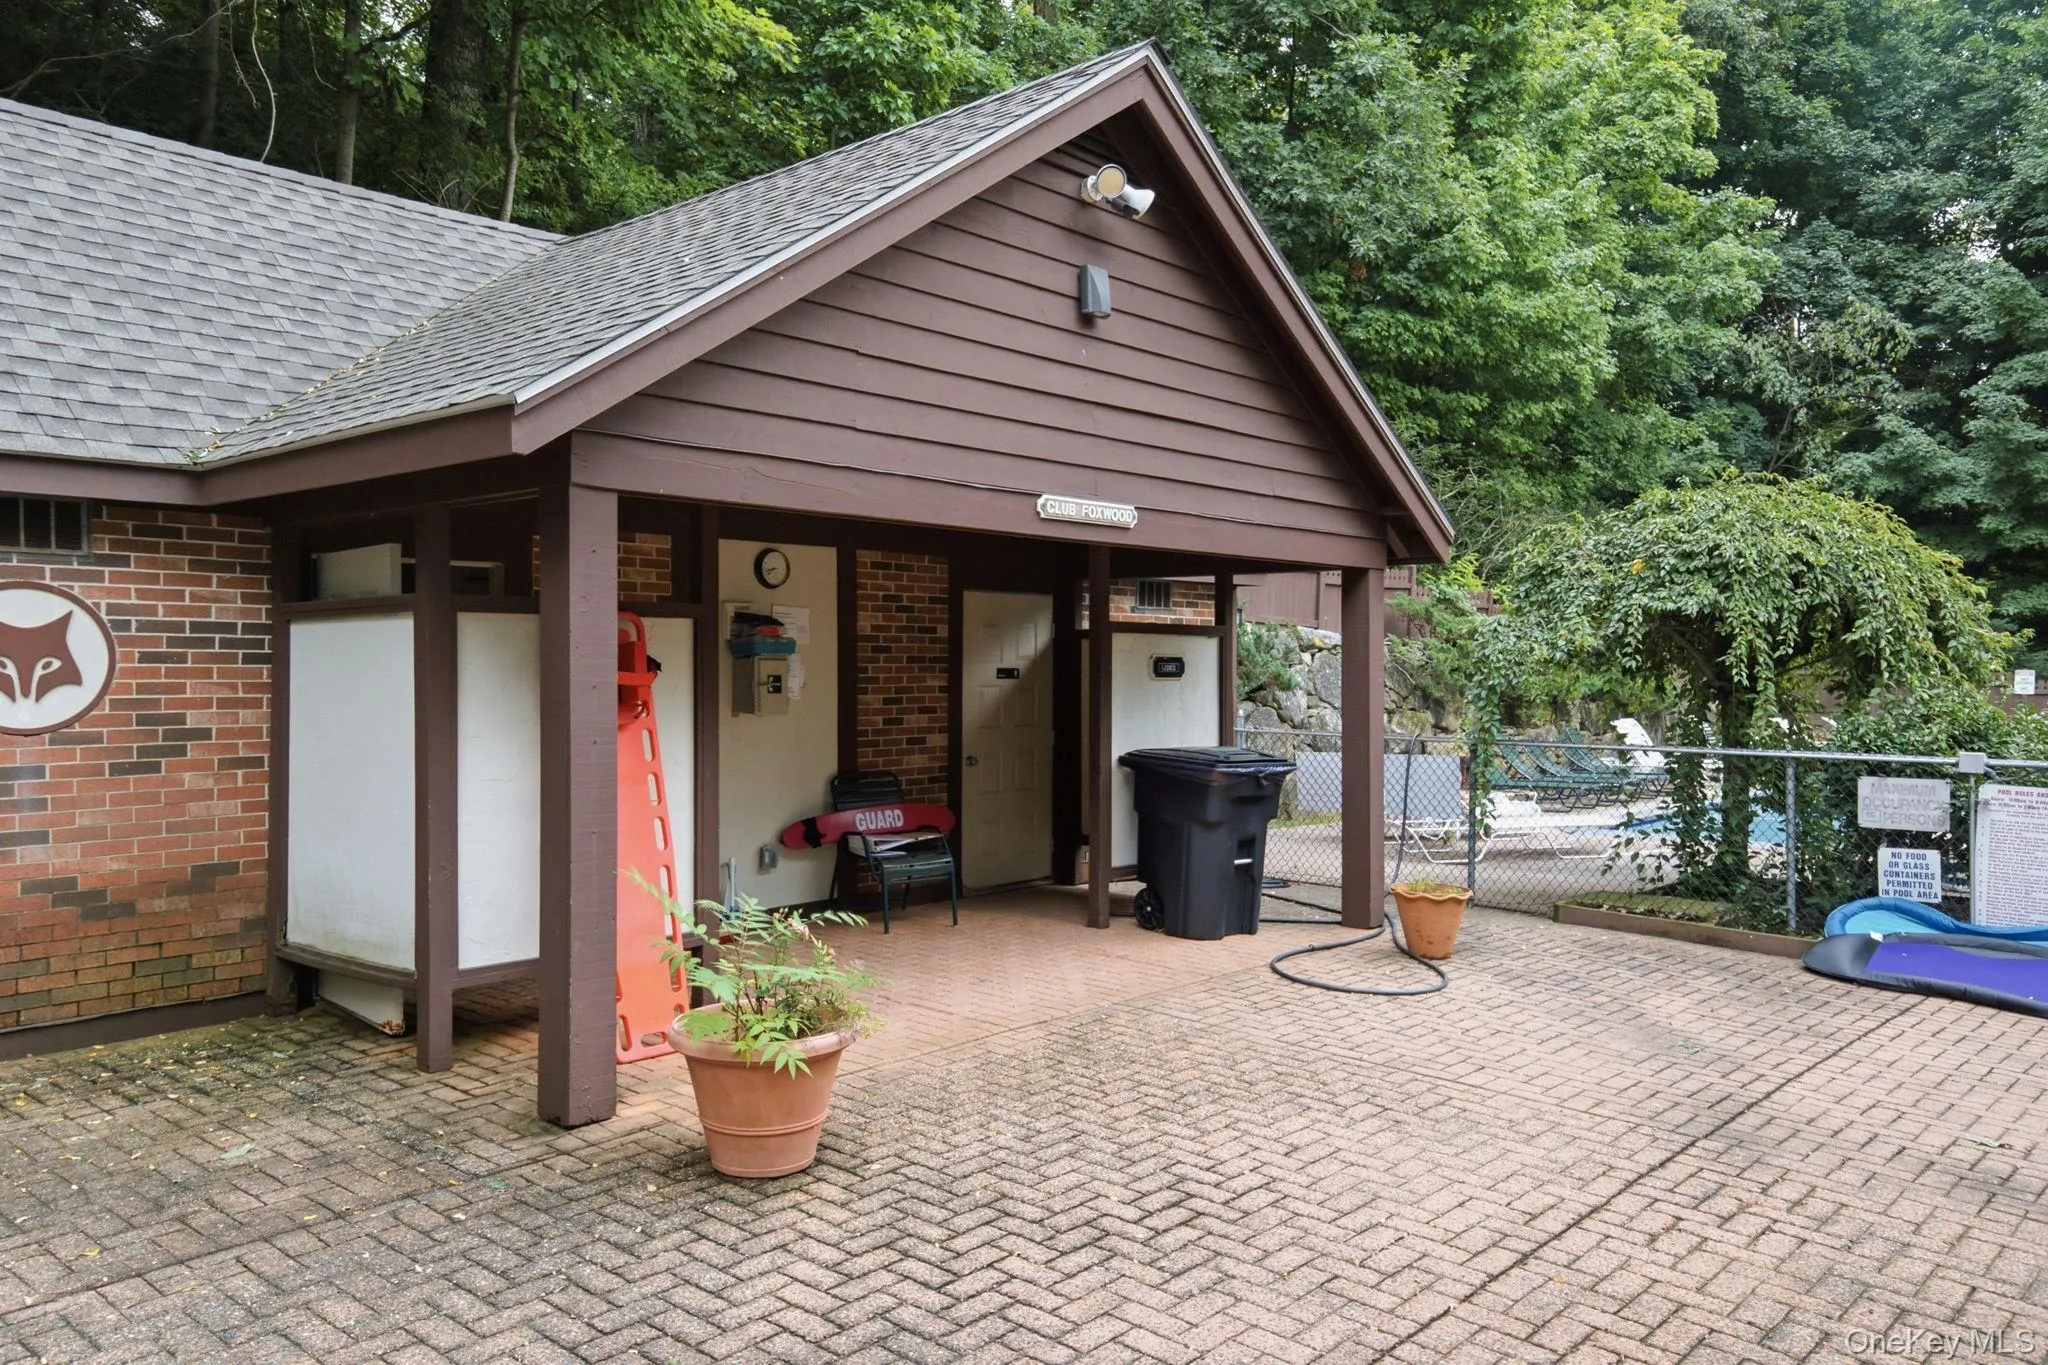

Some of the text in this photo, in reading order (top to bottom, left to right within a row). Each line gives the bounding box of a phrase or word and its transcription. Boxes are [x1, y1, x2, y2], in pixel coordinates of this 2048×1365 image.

[1046, 500, 1133, 523] CLUB FOXWOOD
[1870, 782, 1937, 798] MAXIMUM
[1997, 788, 2012, 796] POOL
[855, 808, 905, 831] GUARD
[1882, 812, 1946, 828] PERSONS
[1891, 851, 1927, 861] NO FOOD
[1888, 861, 1930, 871] OR GLASS
[1883, 870, 1936, 880] CONTAINERS
[1886, 879, 1933, 890] PERMITTED
[1881, 888, 1939, 900] IN POOL AREA
